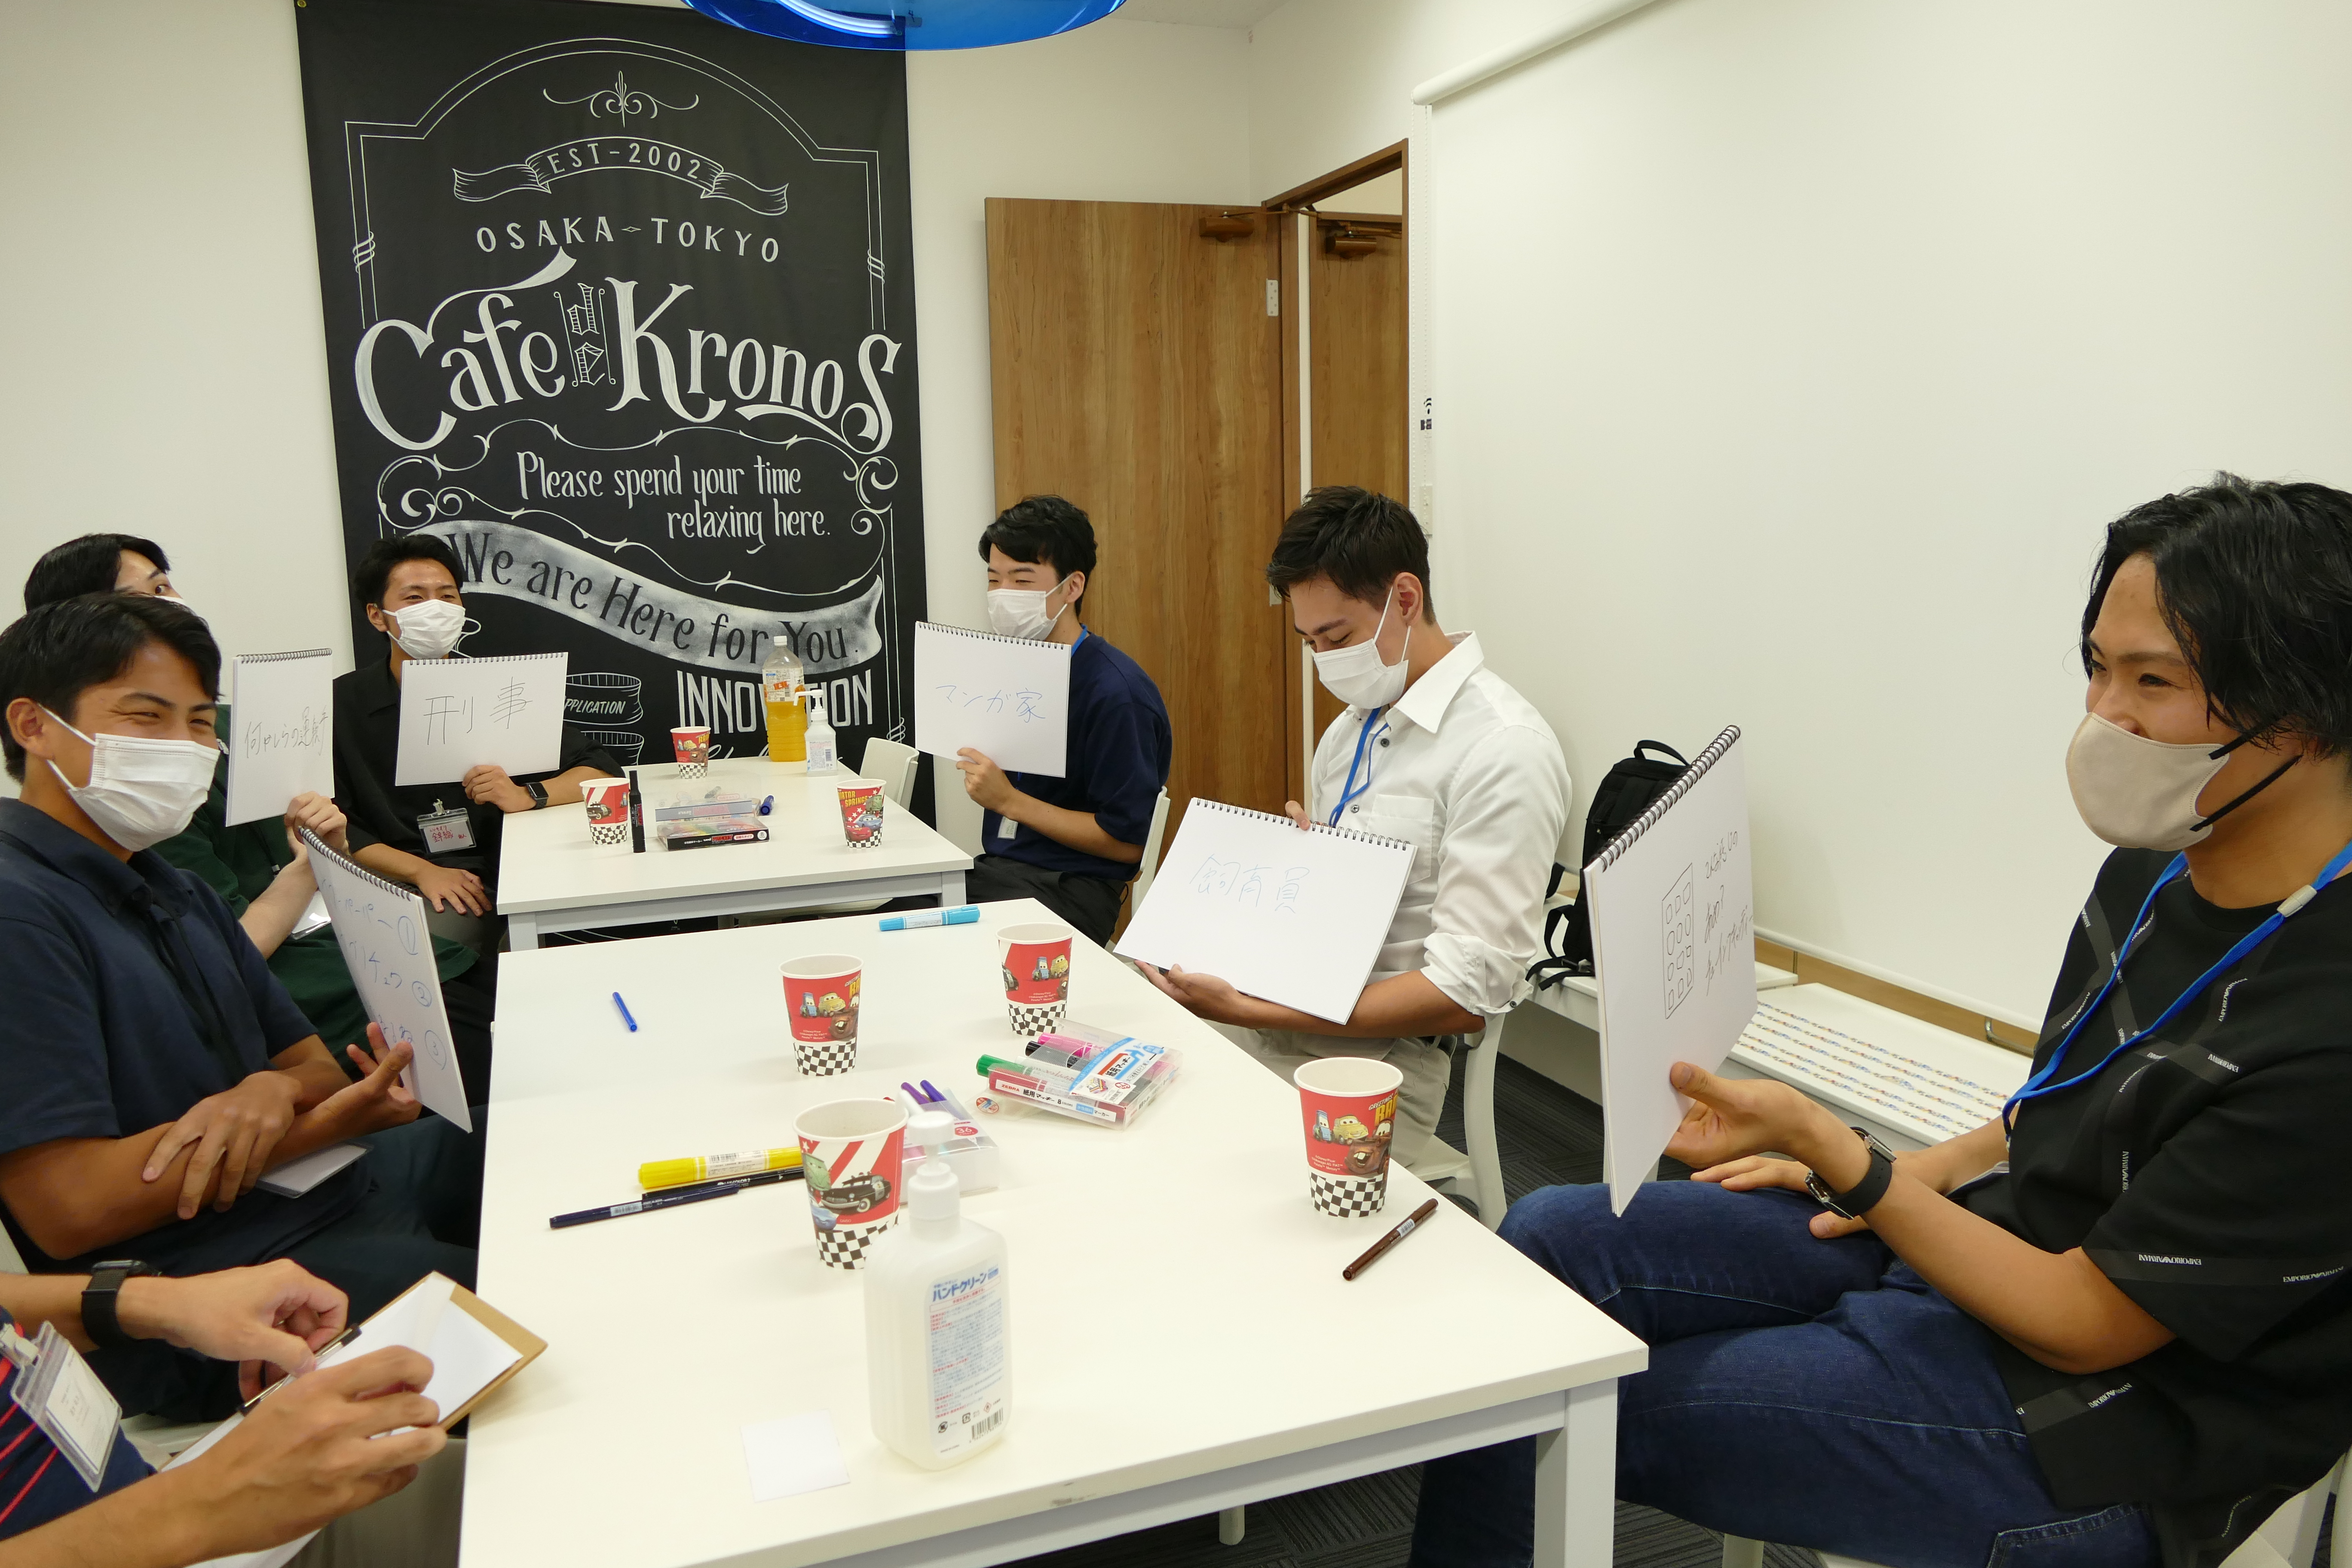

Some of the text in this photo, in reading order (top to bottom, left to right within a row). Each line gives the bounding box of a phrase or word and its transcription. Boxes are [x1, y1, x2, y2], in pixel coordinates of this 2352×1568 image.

[476, 215, 779, 262] OSAKA TOKYO
[518, 452, 802, 508] Please spend your time
[667, 499, 830, 554] relaxing here.
[448, 532, 513, 585] We
[528, 561, 593, 610] are
[600, 576, 695, 652] Here
[708, 613, 769, 663] for
[423, 677, 533, 745] 刑事
[564, 698, 626, 715] PPLICATION
[936, 685, 1046, 723] マンガ家
[1190, 854, 1310, 914] 飼育員
[1001, 1084, 1020, 1092] ZEBRA
[1023, 1089, 1055, 1102] 紙用マッキー
[932, 1272, 986, 1302] ハンドクリーン
